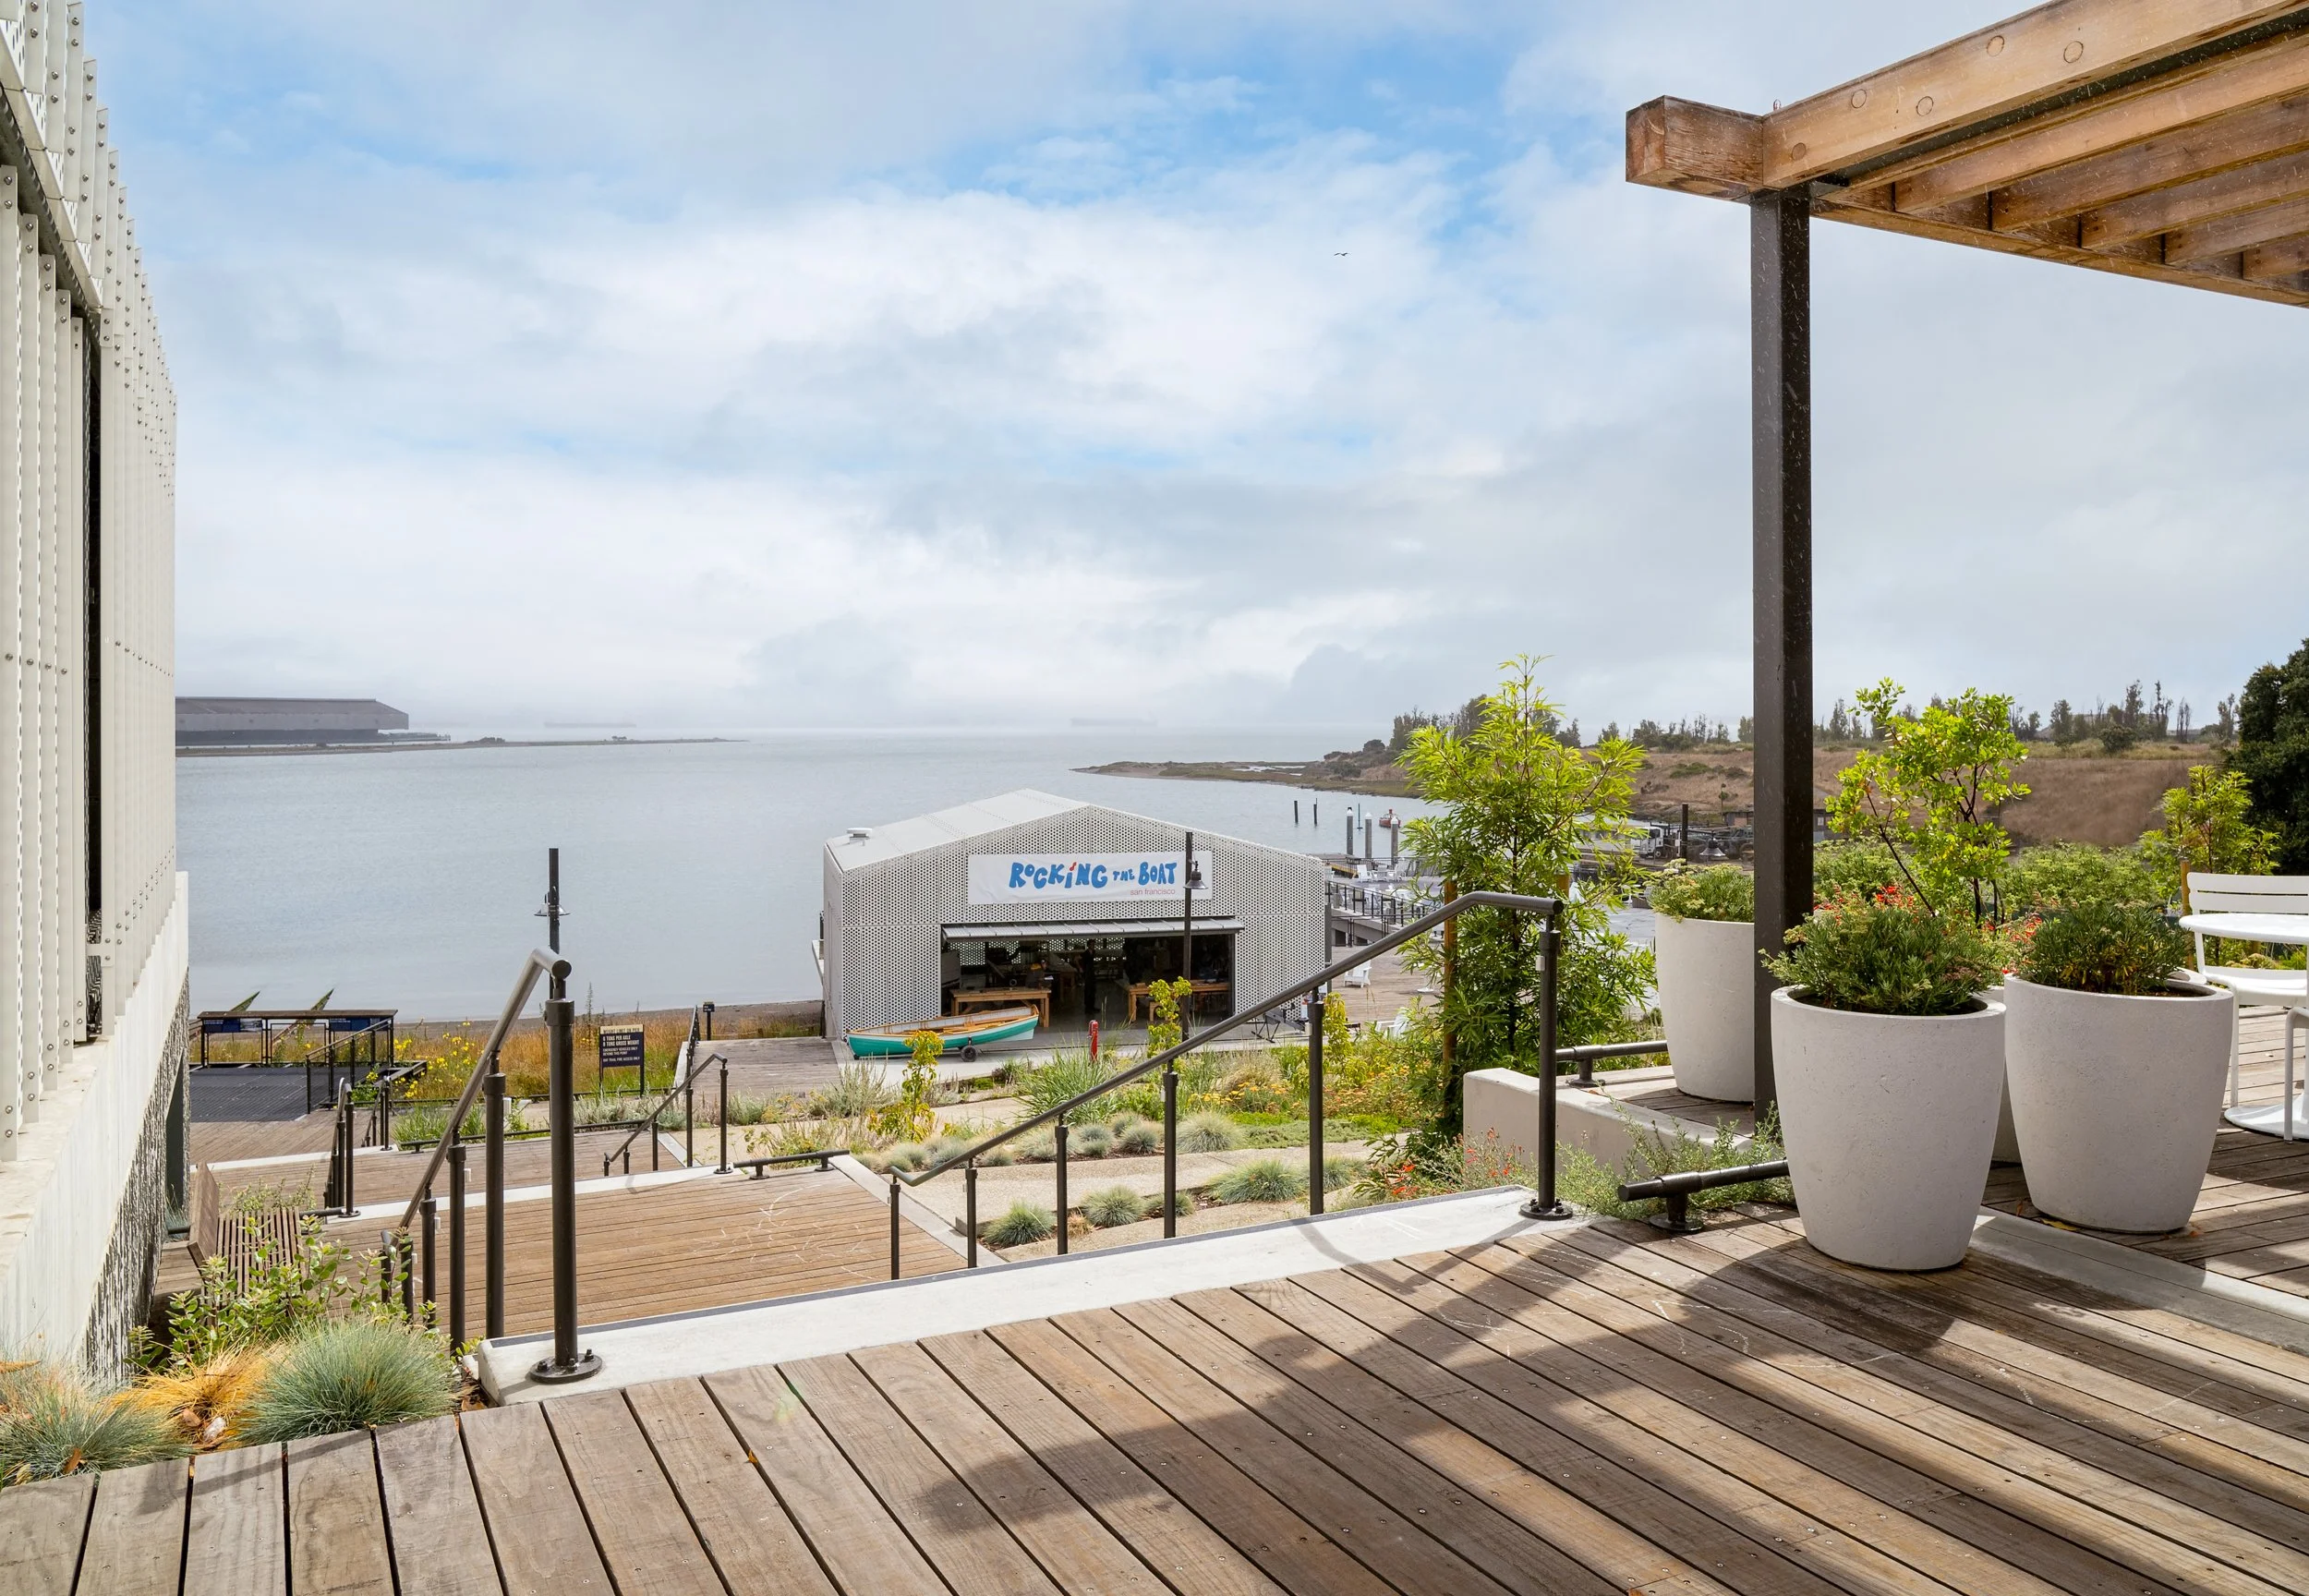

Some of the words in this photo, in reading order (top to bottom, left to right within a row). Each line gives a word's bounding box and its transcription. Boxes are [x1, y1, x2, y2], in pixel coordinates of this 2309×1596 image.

[1113, 868, 1135, 881] THE
[1138, 861, 1178, 886] BOAT
[1144, 888, 1176, 896] francisco
